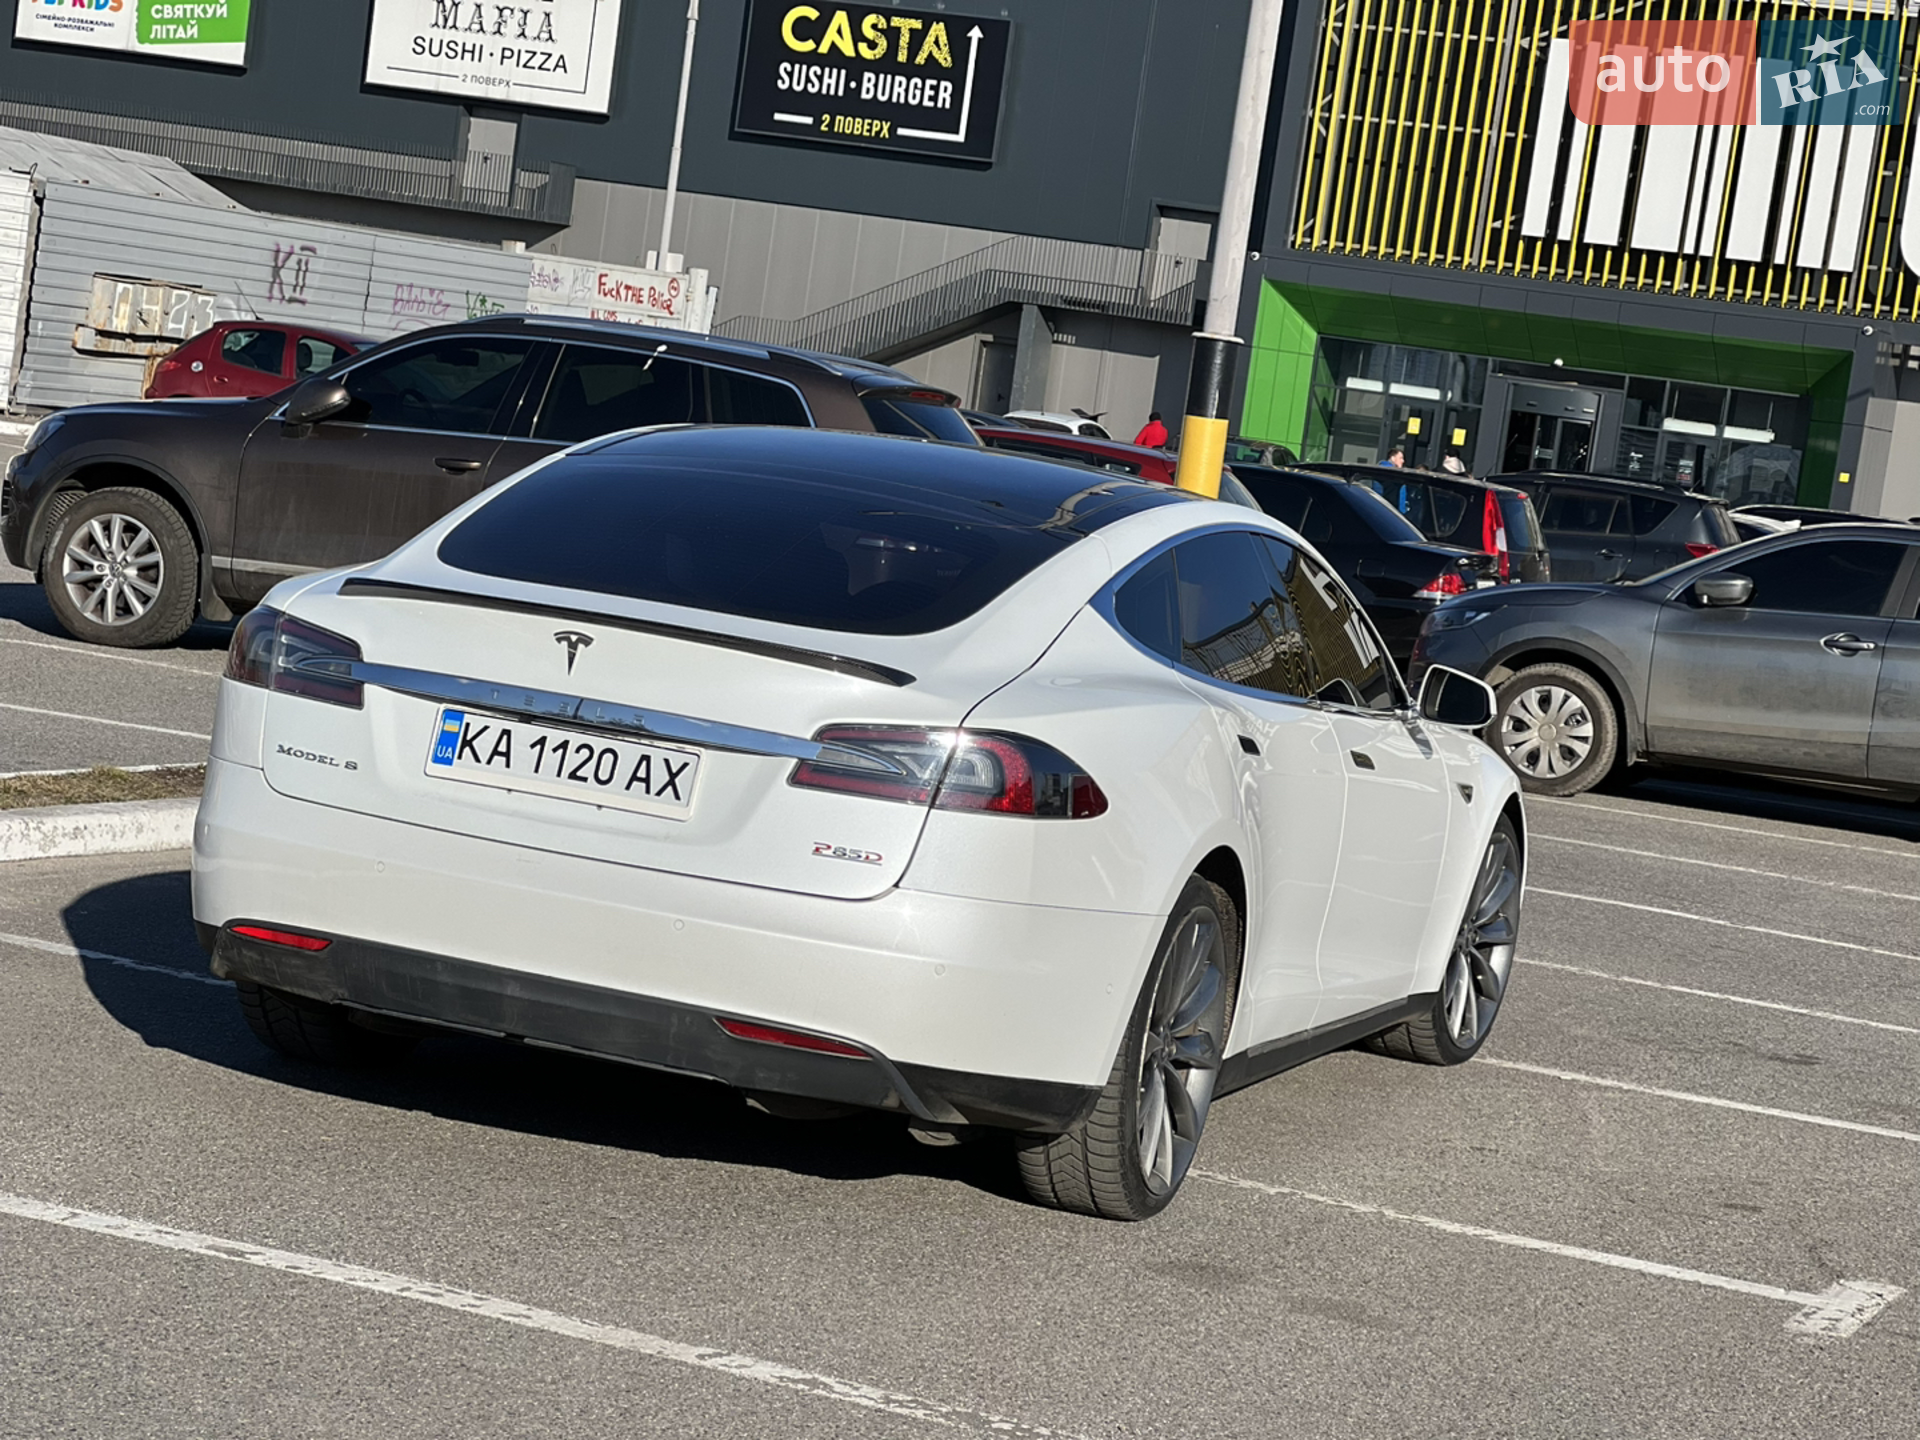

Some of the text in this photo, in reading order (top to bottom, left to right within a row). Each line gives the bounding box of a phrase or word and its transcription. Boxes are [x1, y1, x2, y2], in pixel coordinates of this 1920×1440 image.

[151, 0, 228, 19] СВЯТКУЙ
[429, 0, 557, 43] MAFIA
[149, 21, 198, 39] ЛІТАЙ
[781, 5, 953, 68] CASTA
[412, 35, 568, 74] SUSHI PIZZA
[461, 74, 512, 88] 2 ПОВЕРХ
[777, 61, 953, 109] SUSHI BURGER
[820, 113, 891, 138] 2 ПОВЕРХ
[343, 760, 359, 771] S
[437, 746, 453, 760] UA
[457, 722, 690, 801] KA 1120 AX
